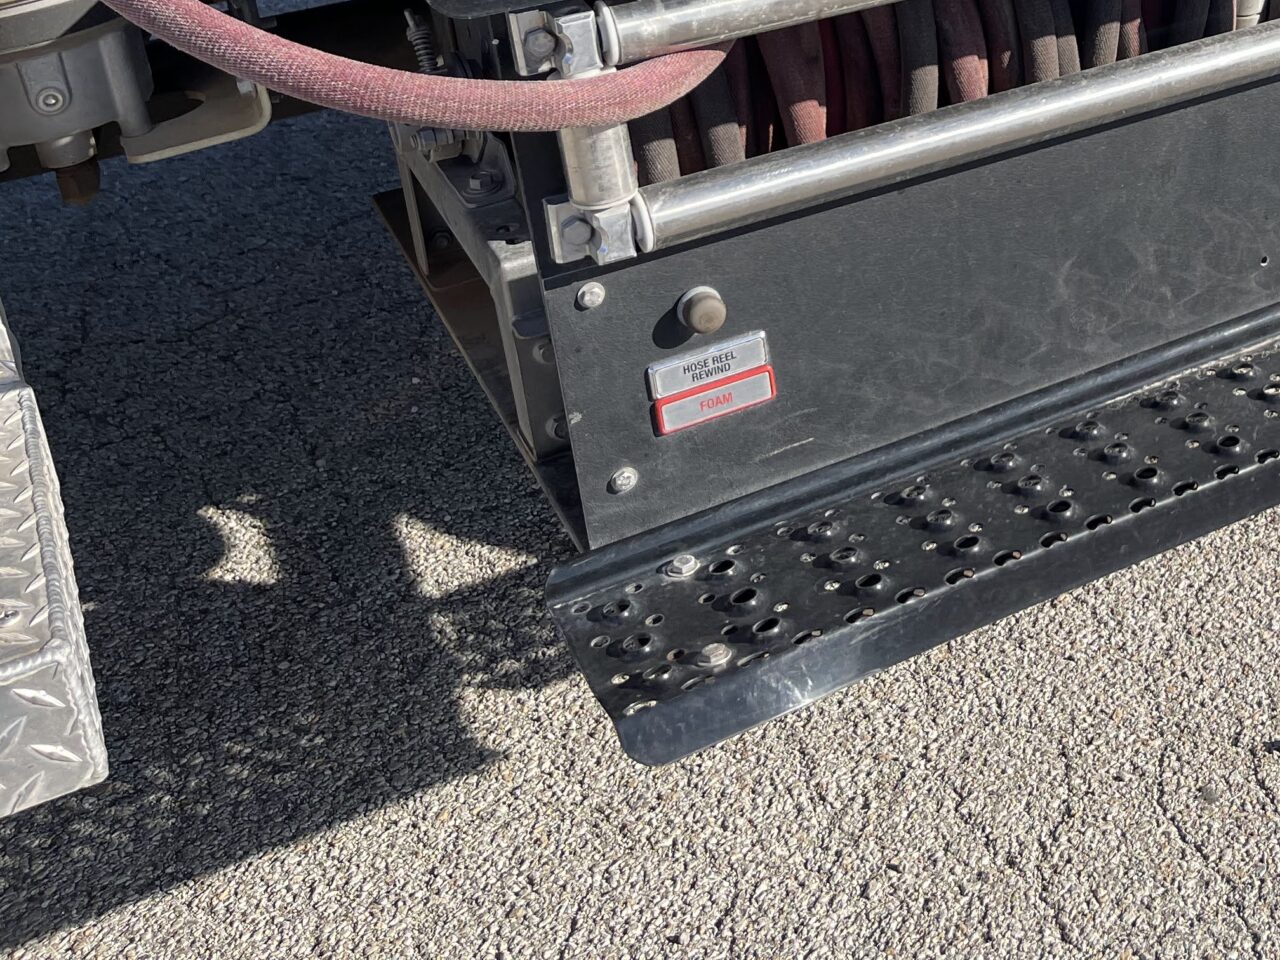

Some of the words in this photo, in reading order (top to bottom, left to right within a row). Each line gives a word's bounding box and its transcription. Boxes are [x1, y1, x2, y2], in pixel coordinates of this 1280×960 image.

[683, 358, 710, 375] HOSE
[712, 351, 737, 366] REEL
[692, 362, 731, 382] REWIND
[700, 392, 733, 412] FOAM
